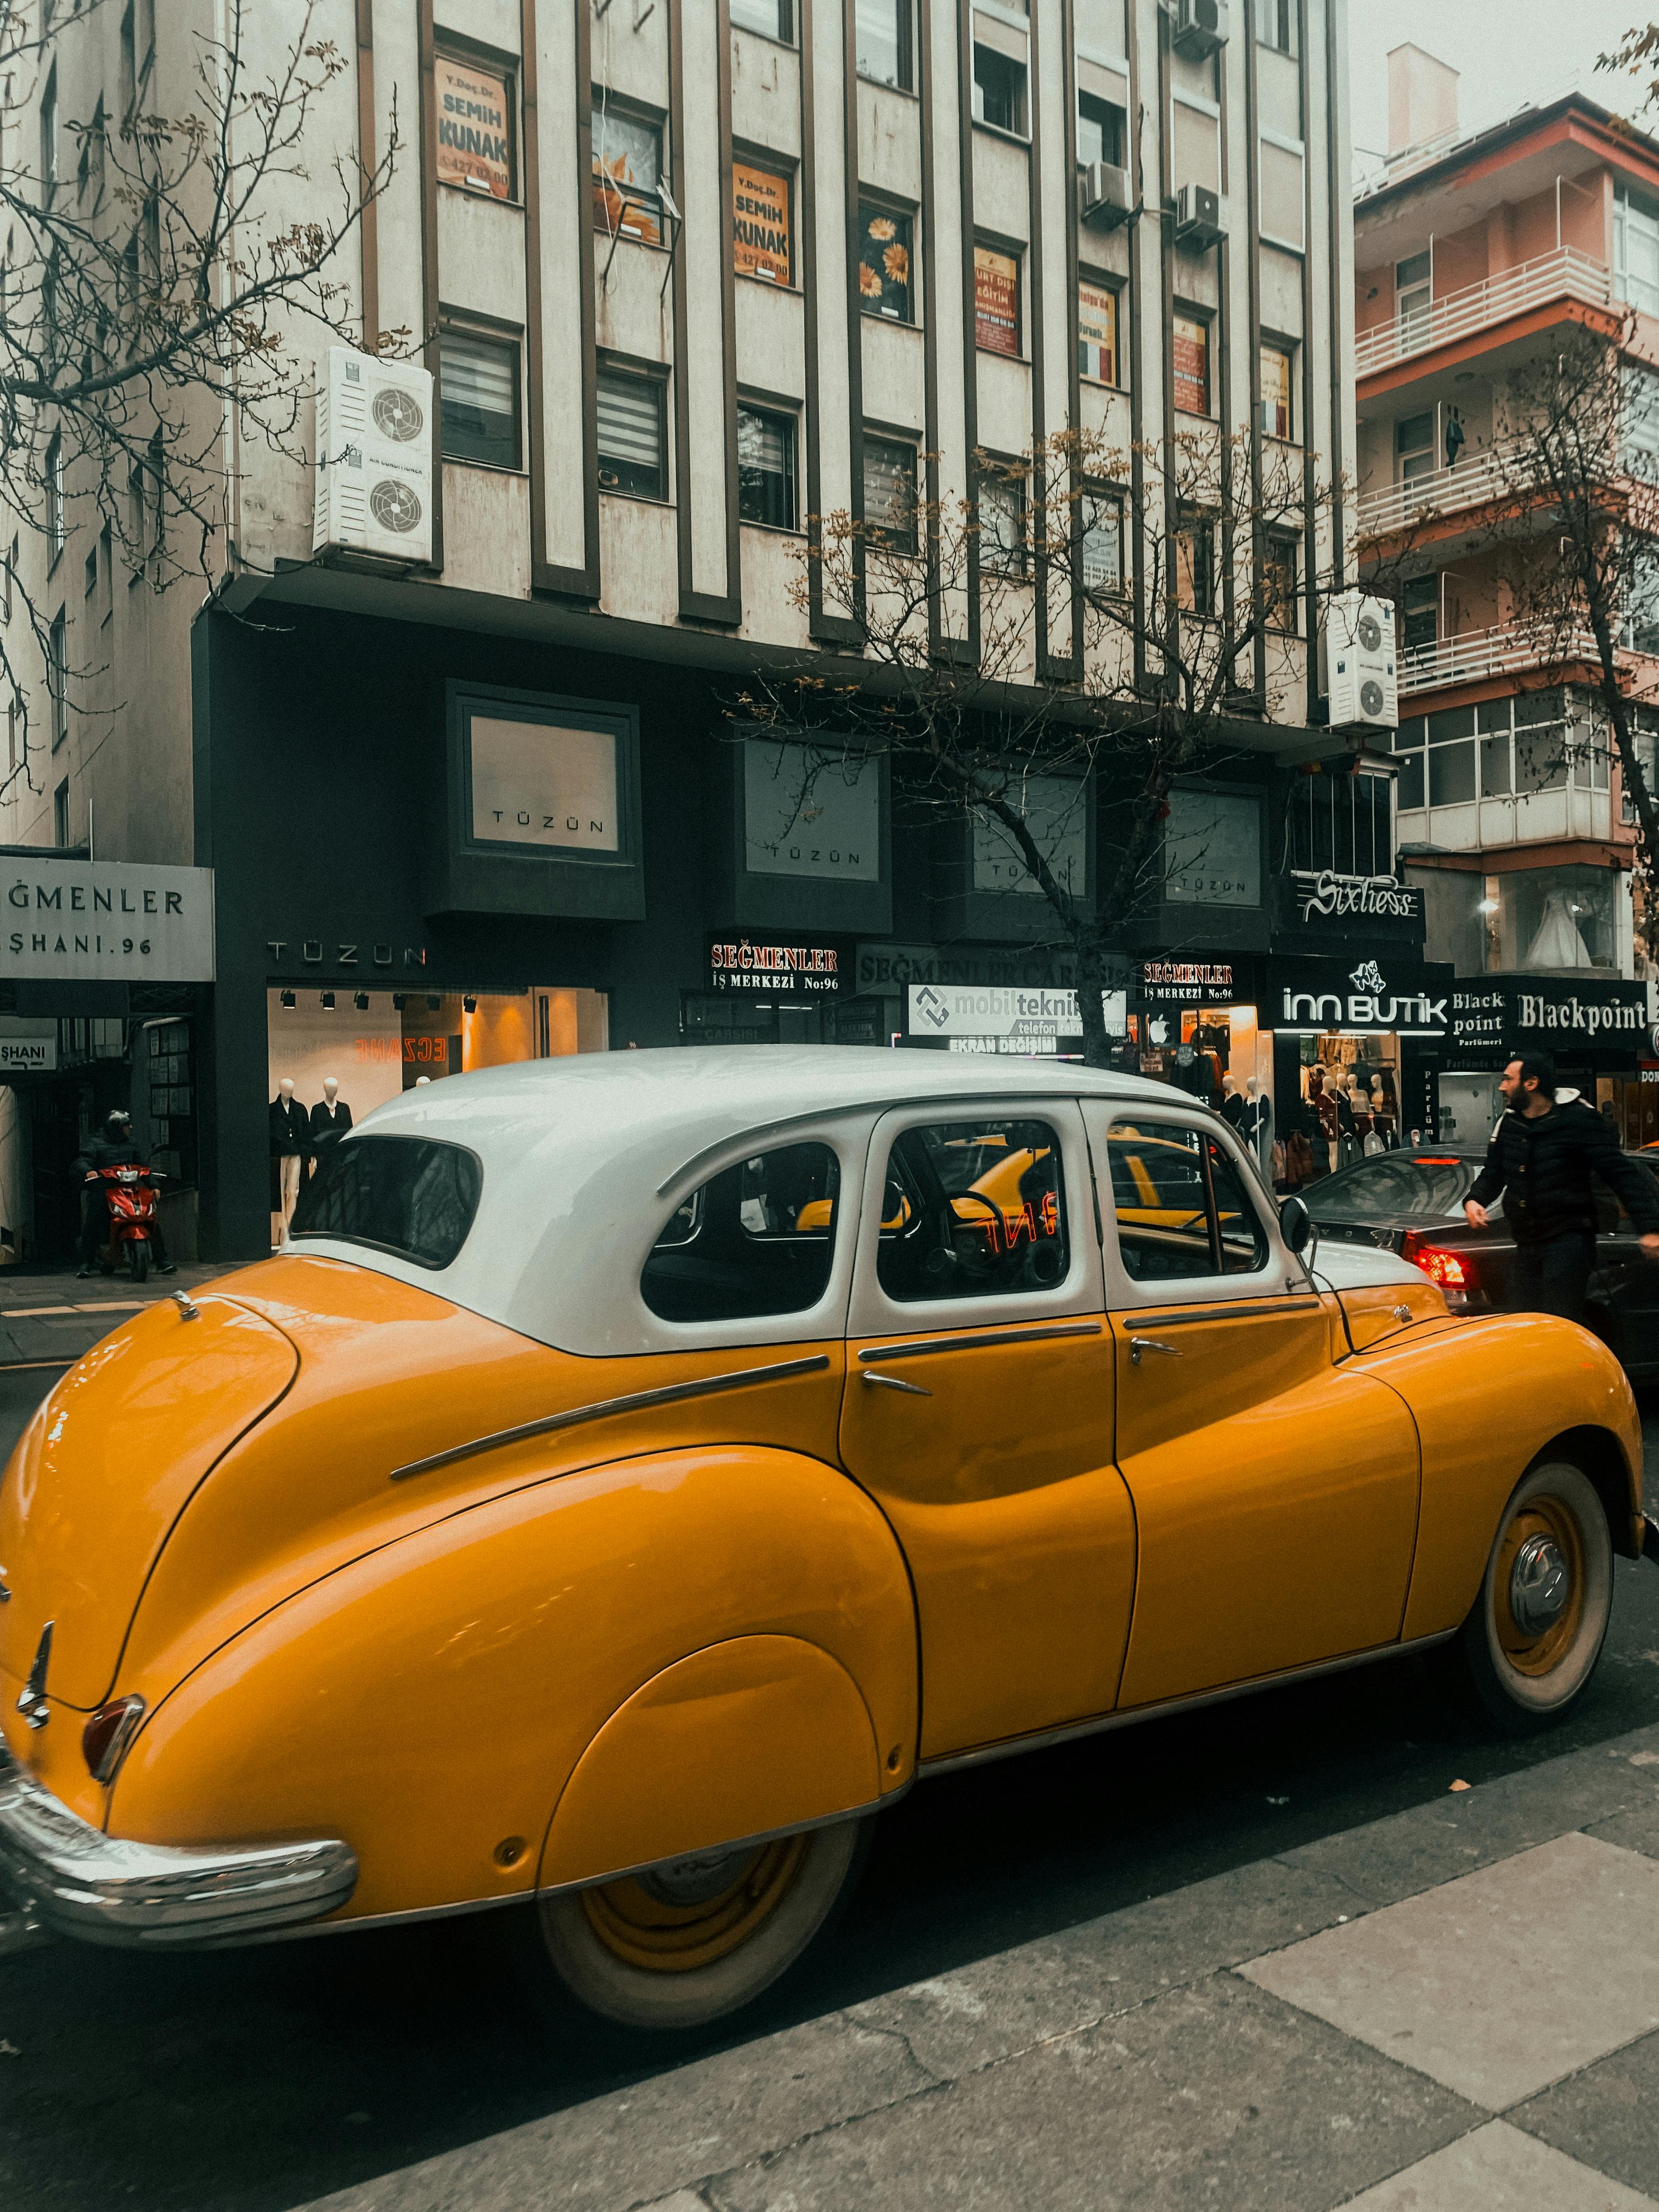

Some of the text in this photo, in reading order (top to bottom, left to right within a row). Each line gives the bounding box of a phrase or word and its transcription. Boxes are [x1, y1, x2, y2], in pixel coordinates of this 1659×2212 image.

[444, 94, 501, 128] SEMİH
[439, 117, 509, 165] KUNAK
[736, 194, 783, 224] SEMİH
[733, 217, 787, 257] KUNAK
[976, 268, 993, 284] URT
[977, 285, 1008, 306] EĞİTİM
[975, 300, 1015, 319] ANIŞMANLIĞI
[381, 460, 422, 475] CONDITIONER
[493, 810, 602, 833] TÜZÜN
[770, 846, 859, 864] TÜZÜN
[992, 864, 1067, 881] TÜN
[1181, 877, 1245, 893] TÜZÜN
[0, 879, 184, 915] ĞMENLER
[0, 932, 151, 955] ŞHANI.96
[268, 940, 426, 966] TÜZÜN
[712, 939, 838, 973] SEĞMENLER
[713, 970, 838, 990] İŞ MERKEZİ No:96
[1144, 957, 1233, 984] SEĞMENLER
[1144, 985, 1233, 1001] İŞ MERKEZİ No:96
[1453, 991, 1505, 1009] Black
[1454, 1014, 1504, 1035] point
[1517, 994, 1646, 1036] Blackpoint
[1018, 1020, 1056, 1035] telefon
[1059, 1021, 1084, 1035] tekn
[950, 1037, 996, 1053] EKRAN
[1459, 1038, 1502, 1046] Parfümeri
[1424, 1070, 1434, 1135] Parfüm
